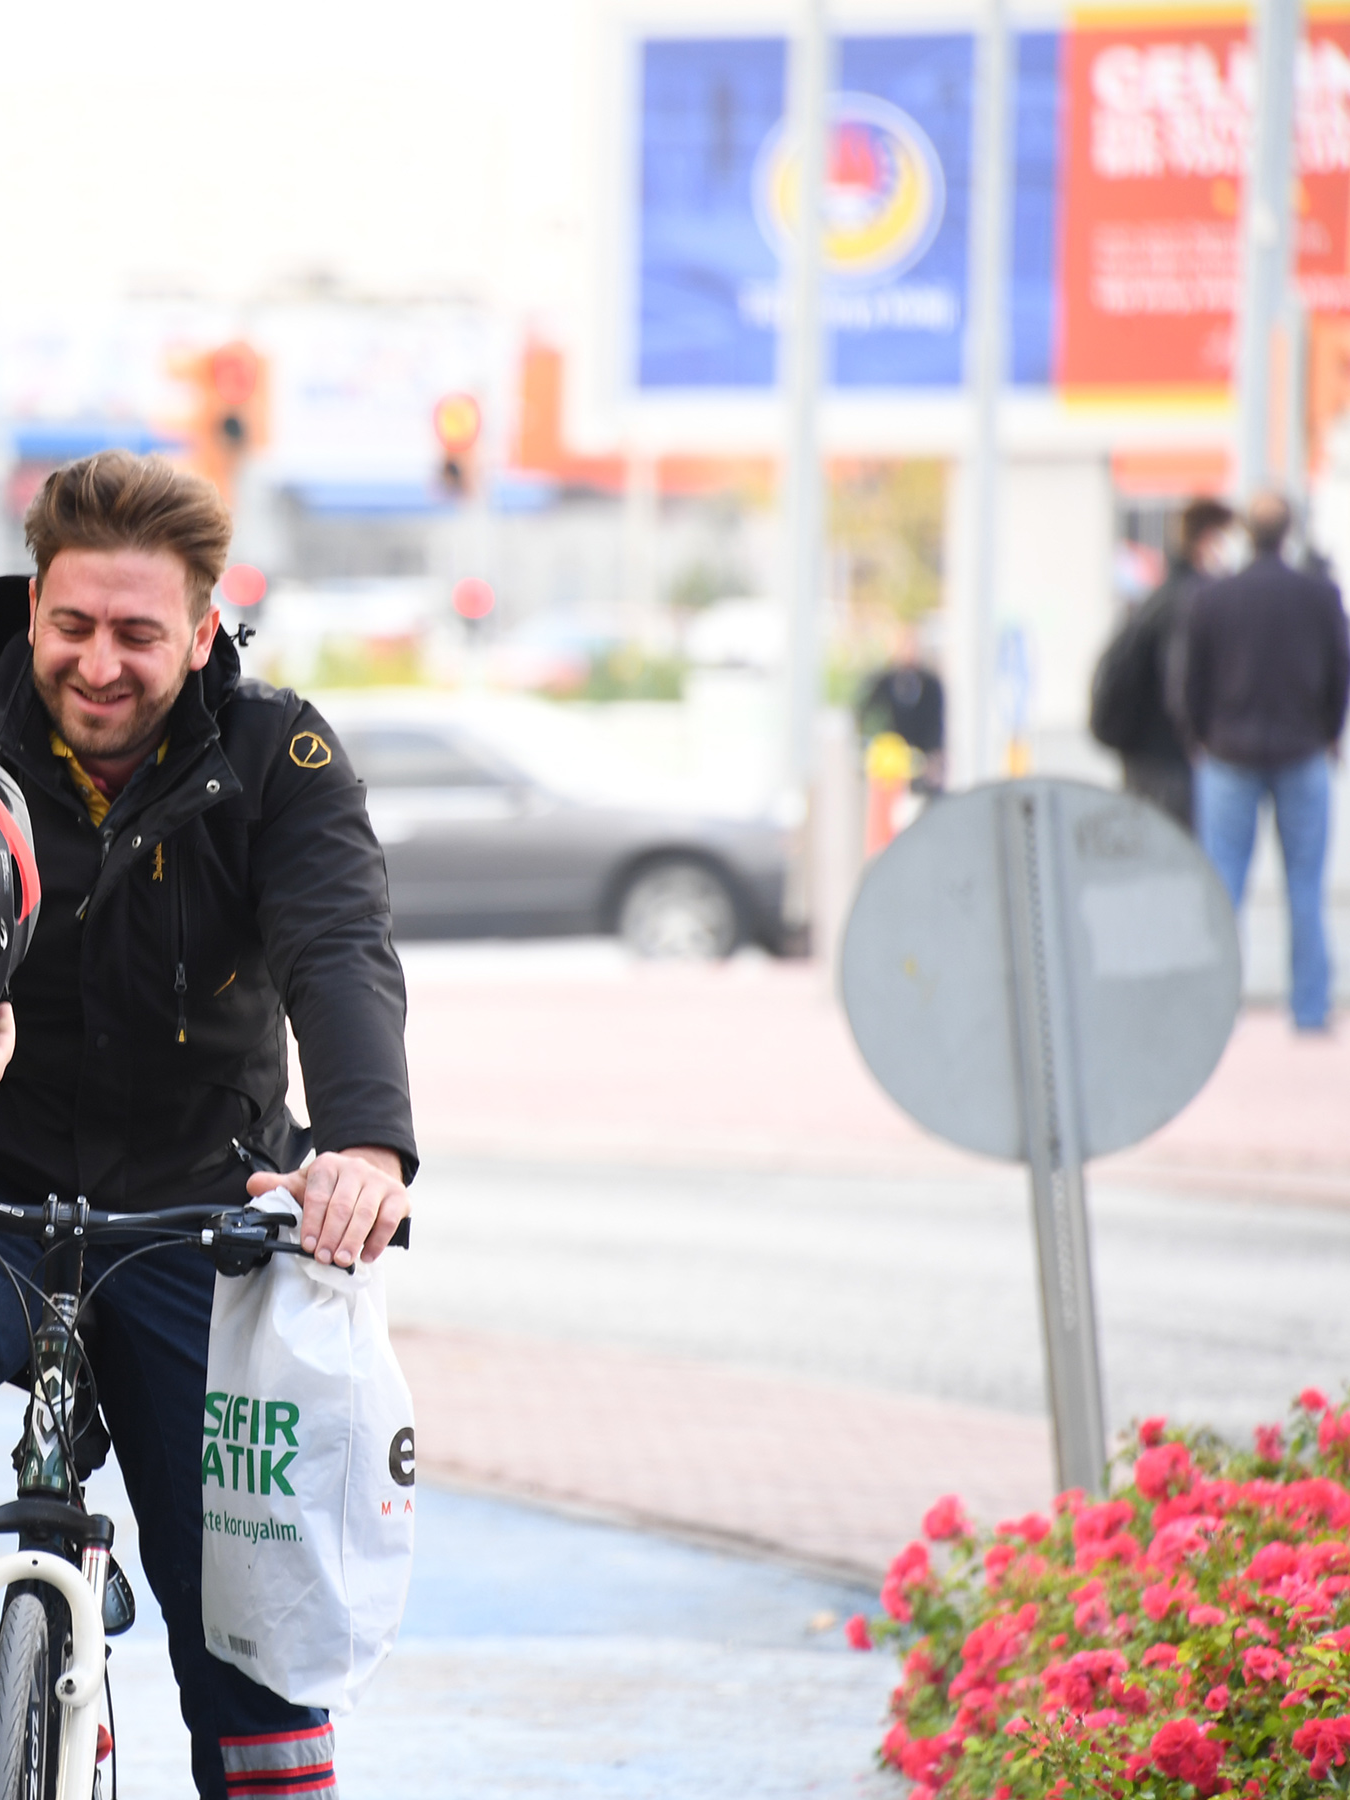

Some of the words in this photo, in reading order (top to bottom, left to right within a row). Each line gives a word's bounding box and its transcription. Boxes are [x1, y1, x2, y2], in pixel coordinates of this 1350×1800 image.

[203, 1391, 300, 1447] SIFIR
[202, 1441, 299, 1497] ATIK
[223, 1510, 303, 1545] koruyalım.
